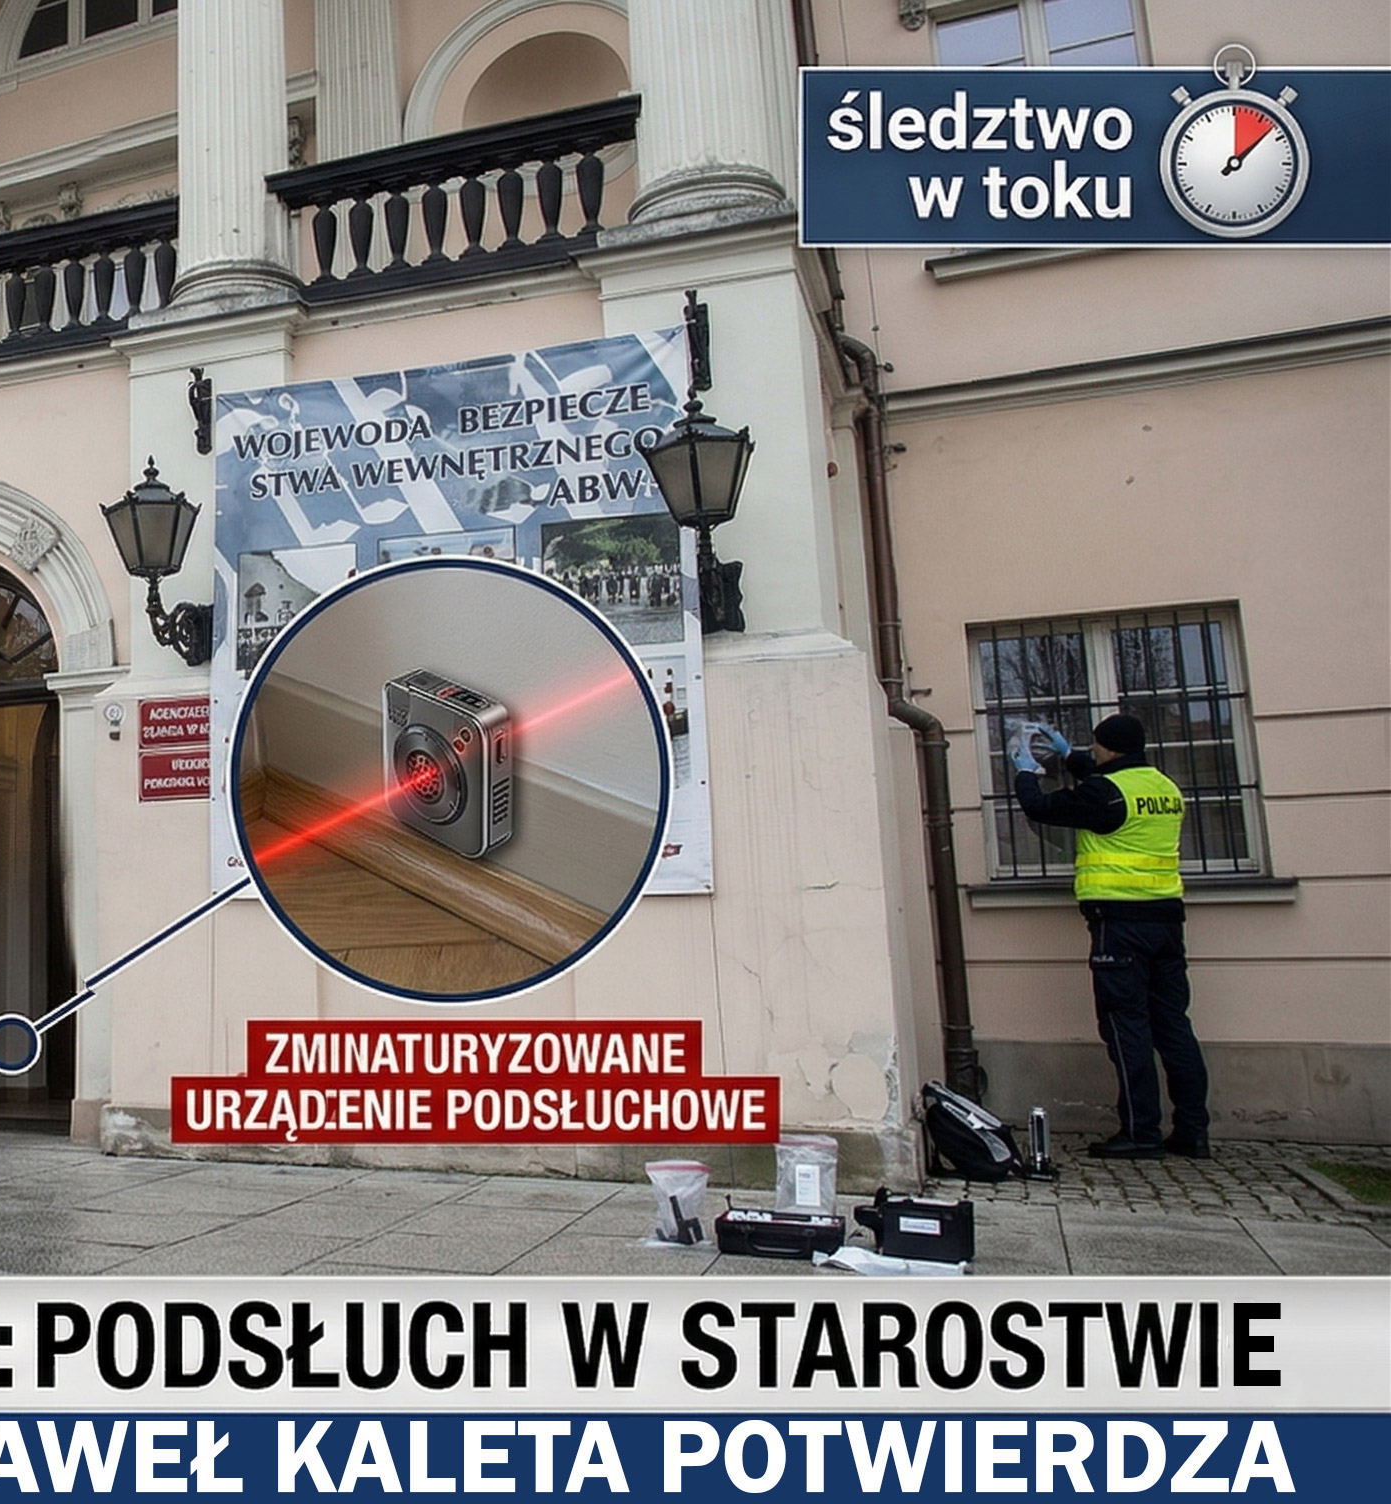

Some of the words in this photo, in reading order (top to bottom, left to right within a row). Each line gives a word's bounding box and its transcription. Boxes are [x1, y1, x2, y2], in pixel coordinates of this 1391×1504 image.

[232, 414, 432, 461] WOJEWODA
[459, 383, 651, 434] BEZPIECZE
[251, 468, 342, 499] STWA
[353, 428, 663, 489] WEWNĘTRZNEGO
[548, 468, 644, 508] ABW
